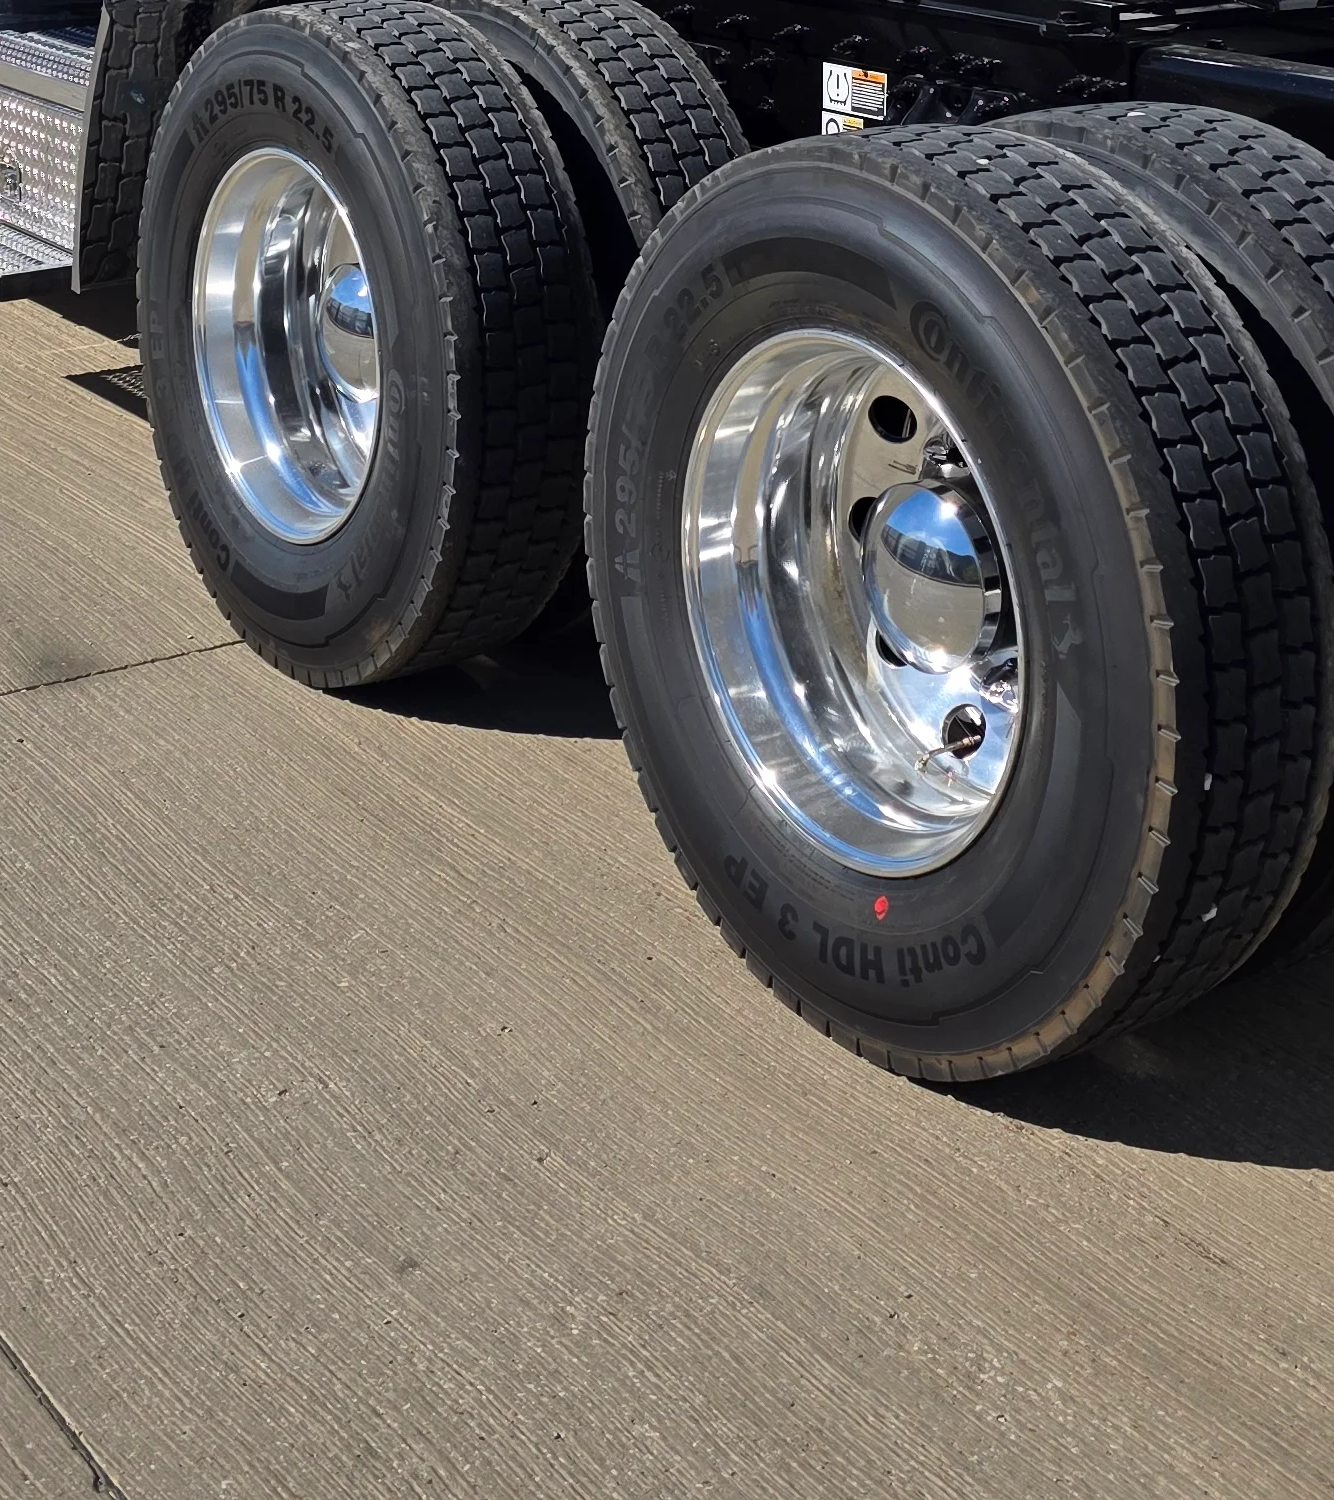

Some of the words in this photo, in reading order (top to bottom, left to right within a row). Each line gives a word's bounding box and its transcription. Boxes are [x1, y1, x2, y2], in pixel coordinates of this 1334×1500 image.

[203, 78, 269, 127] 295/75
[272, 83, 287, 113] R
[291, 95, 334, 154] 22.5
[722, 854, 769, 914] EP
[776, 903, 800, 942] 3
[811, 920, 886, 986] HDL
[896, 923, 987, 988] Conti
